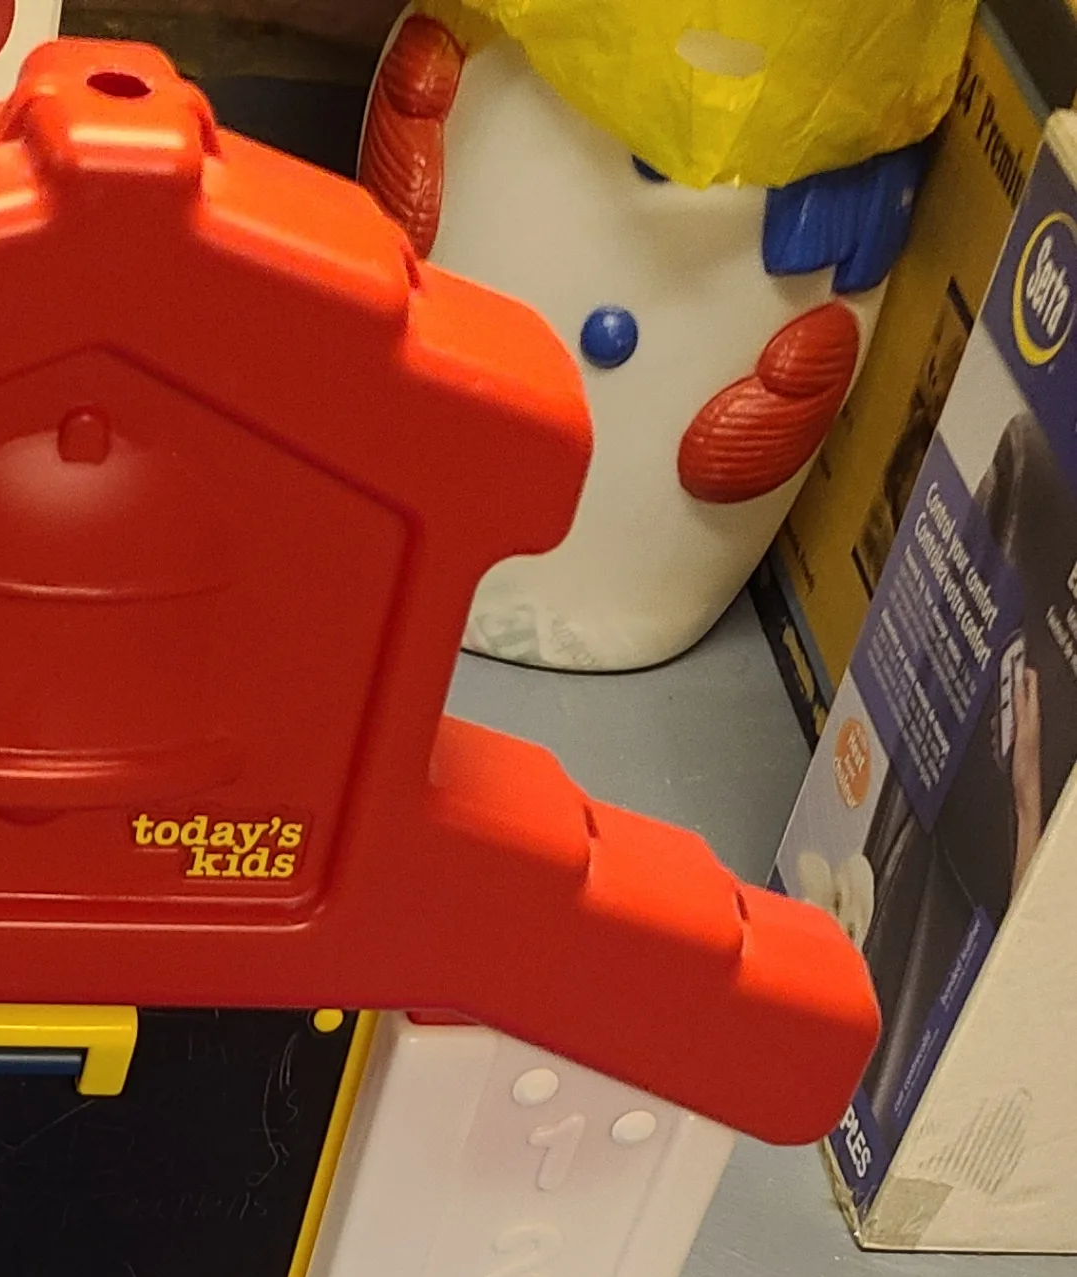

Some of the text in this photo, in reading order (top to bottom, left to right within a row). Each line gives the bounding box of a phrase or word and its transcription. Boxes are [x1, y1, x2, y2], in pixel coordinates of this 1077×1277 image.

[1026, 235, 1070, 338] Serta
[926, 481, 957, 544] Control
[946, 533, 971, 576] your
[132, 813, 303, 854] today's
[186, 847, 296, 878] kids
[526, 1112, 586, 1192] 1
[839, 1103, 872, 1178] PLES
